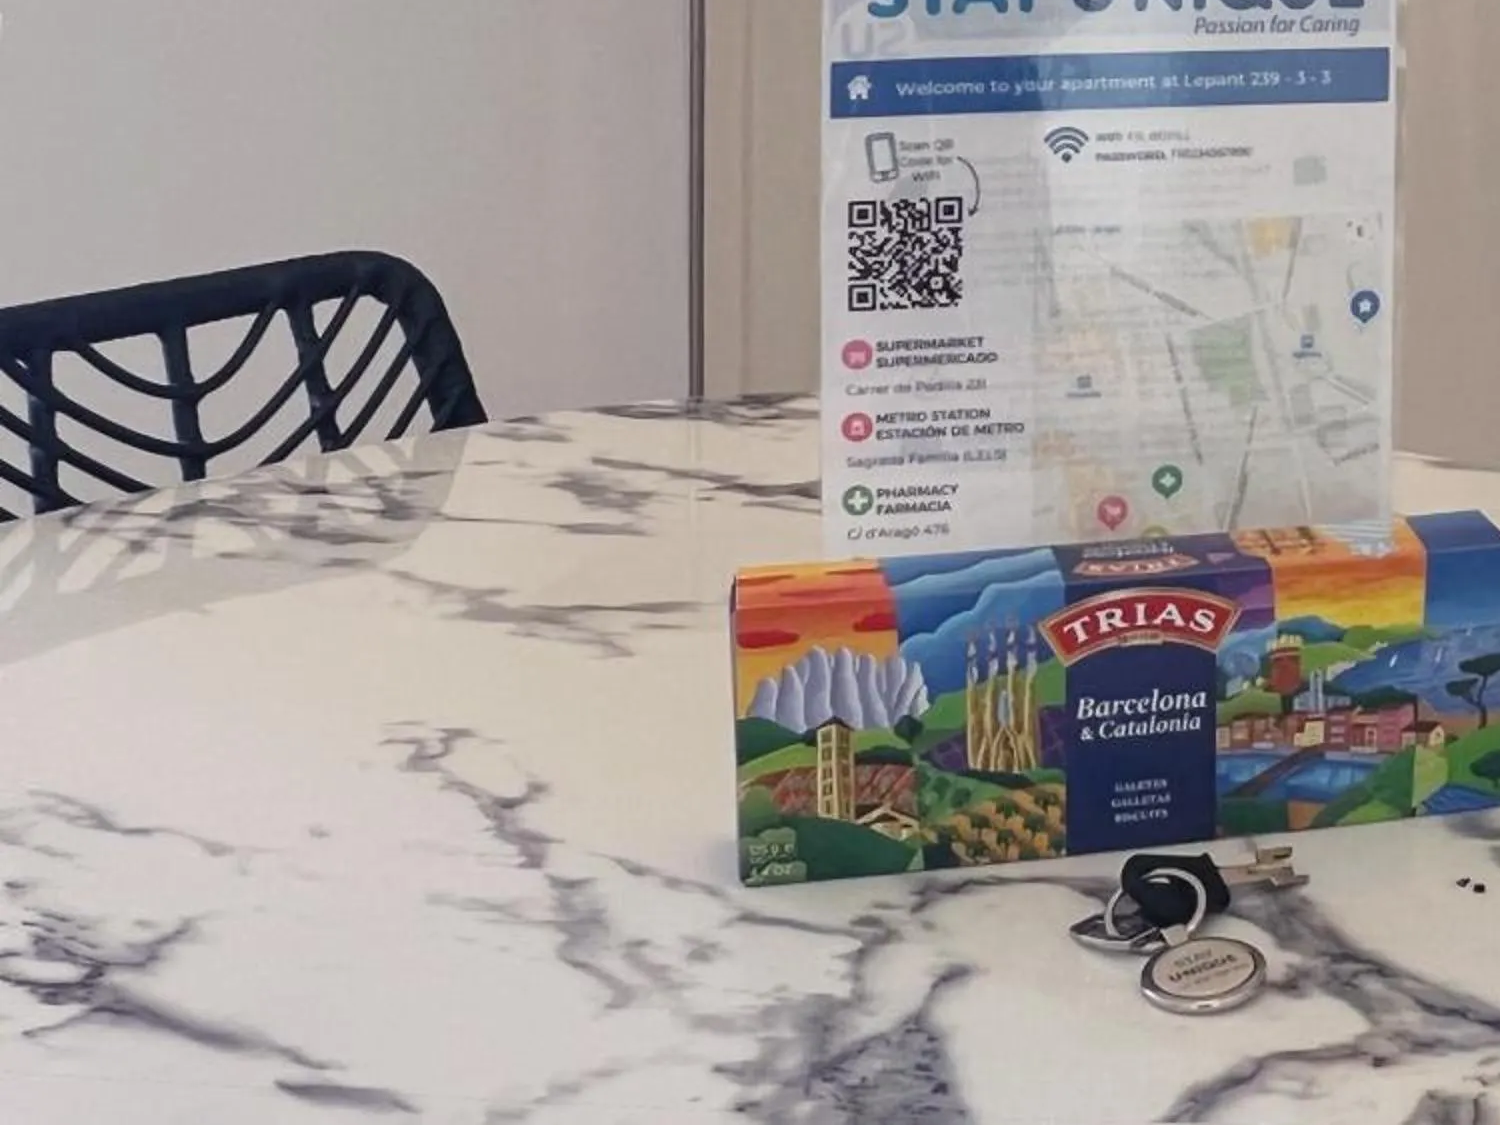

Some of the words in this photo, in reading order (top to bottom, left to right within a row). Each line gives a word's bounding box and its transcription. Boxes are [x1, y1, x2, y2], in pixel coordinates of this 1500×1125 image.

[1194, 16, 1266, 35] Passion
[1269, 14, 1296, 33] for
[1300, 15, 1361, 36] Caring
[896, 80, 985, 96] Welcome
[990, 80, 1010, 93] to
[1013, 79, 1055, 96] your
[1059, 75, 1157, 94] apartment
[1161, 75, 1179, 88] at
[1184, 74, 1246, 90] Lepant
[876, 336, 984, 353] SUPERMARKET
[876, 352, 998, 369] SUPERMERCADO
[876, 411, 928, 424] METRO
[931, 408, 991, 422] STATION
[876, 424, 947, 441] ESTACIÓN
[951, 425, 971, 438] DE
[974, 422, 1025, 437] METRO
[876, 484, 959, 499] PHARMACY
[1063, 602, 1217, 645] TRIAS
[1077, 688, 1208, 720] Barcelona
[1080, 726, 1094, 741] &
[1099, 713, 1201, 740] Catalonia
